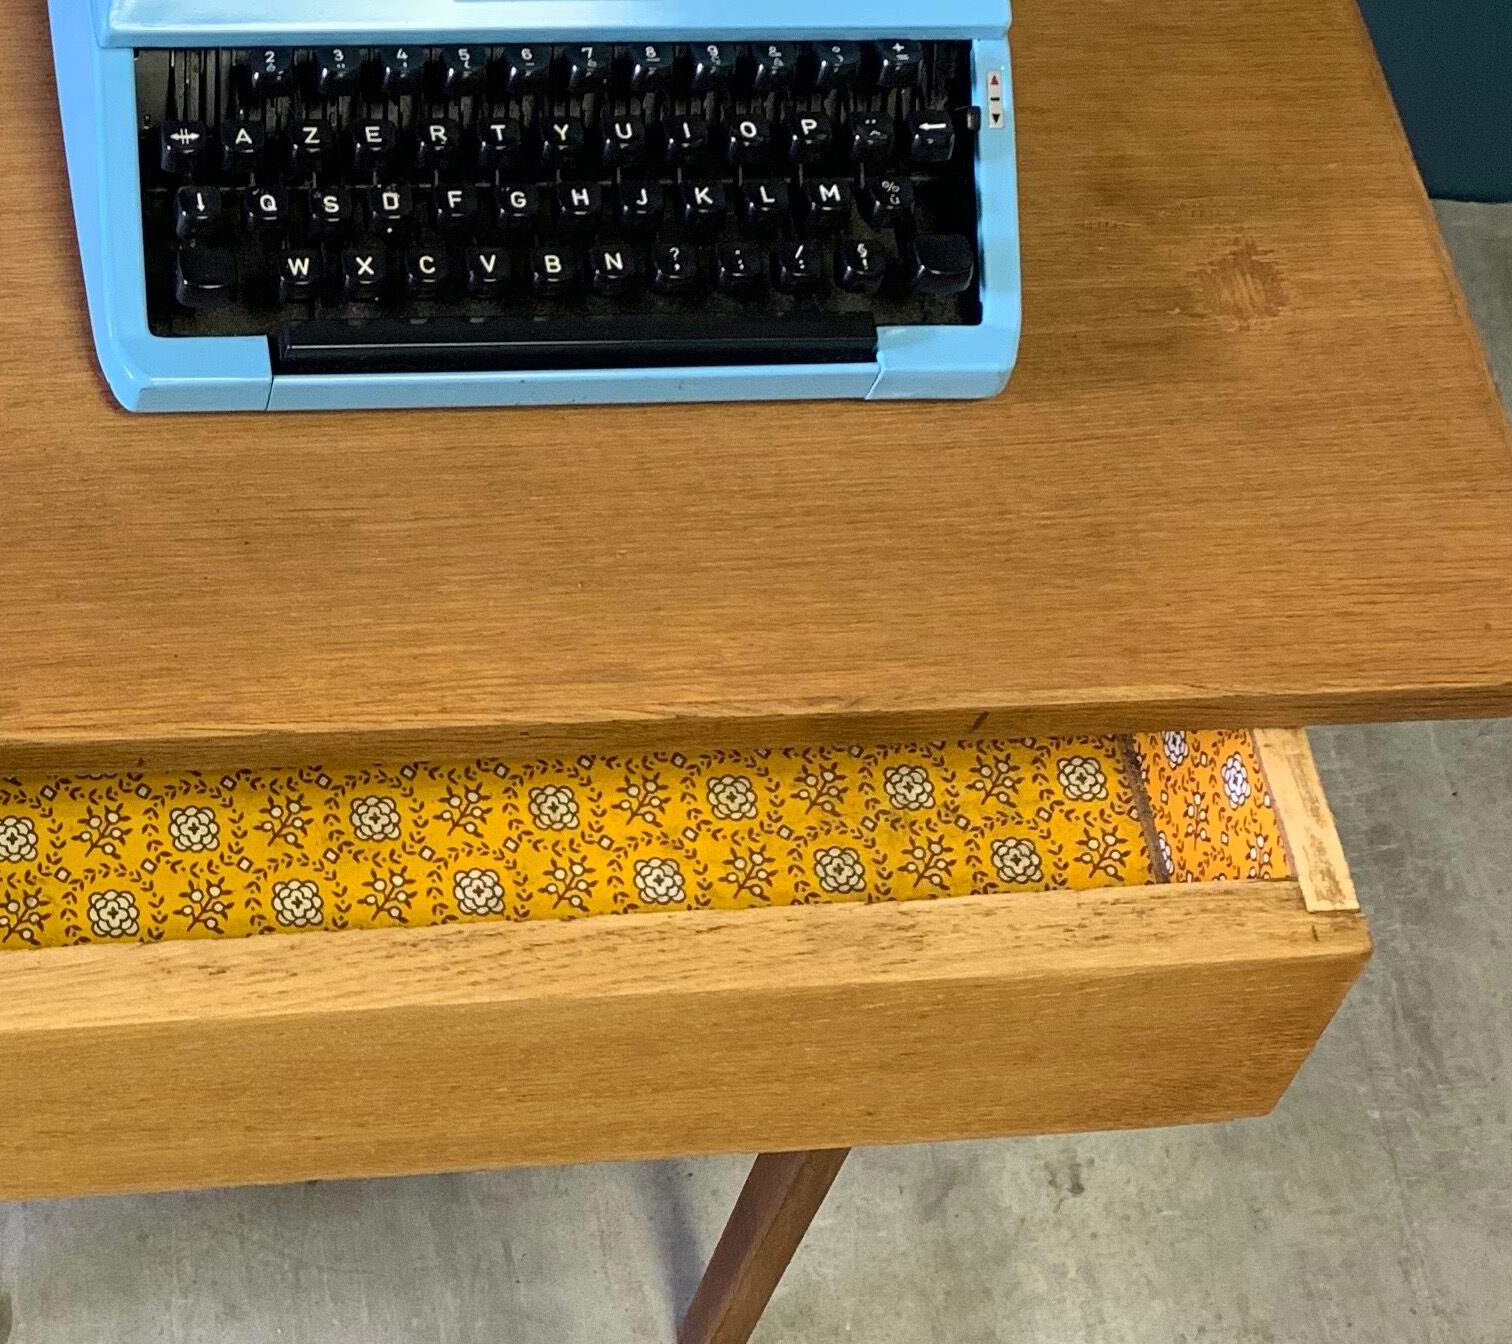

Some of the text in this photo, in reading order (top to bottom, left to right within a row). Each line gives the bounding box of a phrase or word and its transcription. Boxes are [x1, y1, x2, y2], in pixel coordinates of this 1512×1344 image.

[264, 50, 276, 64] 2
[332, 48, 345, 62] 3
[396, 47, 409, 61] 4
[457, 47, 471, 62] 5
[520, 47, 534, 61] 6
[580, 46, 594, 59] 7
[644, 45, 657, 59] 8
[235, 118, 818, 145] A Z E R T Y U I O P
[259, 193, 278, 212] Q
[323, 195, 340, 213] S
[382, 191, 400, 211] D
[447, 190, 463, 209] F
[510, 191, 527, 209] G
[571, 188, 590, 206] H
[636, 188, 648, 206] J
[694, 186, 714, 205] K
[759, 185, 776, 203] L
[819, 184, 841, 202] M
[287, 257, 310, 276] W
[355, 256, 375, 275] X
[419, 255, 436, 274] C
[479, 254, 496, 273] V
[544, 254, 562, 273] B
[604, 252, 624, 270] N
